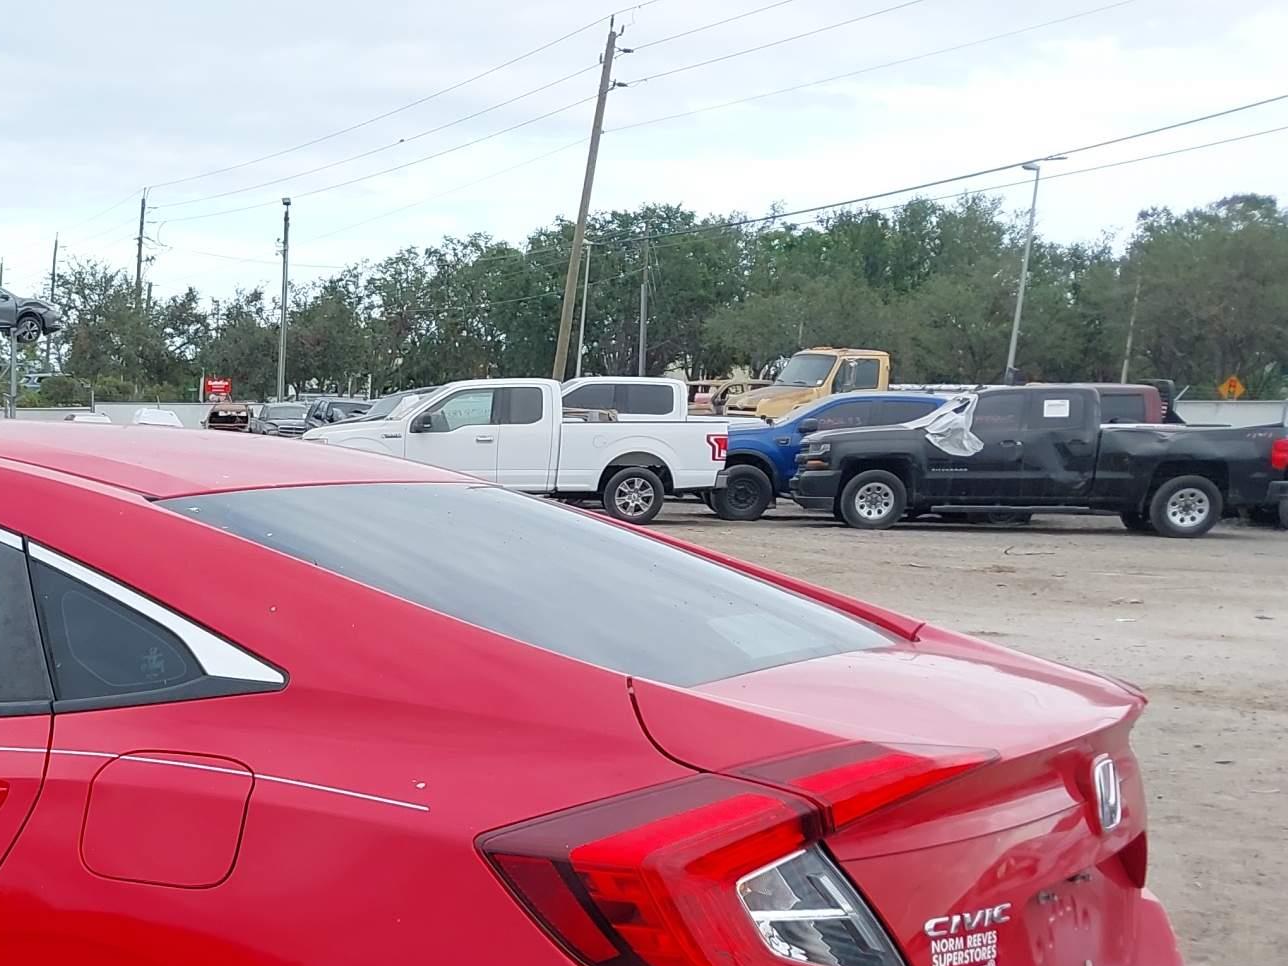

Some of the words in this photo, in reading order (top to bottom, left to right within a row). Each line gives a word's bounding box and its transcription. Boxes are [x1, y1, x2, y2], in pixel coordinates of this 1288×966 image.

[924, 902, 1012, 936] CIVIC
[931, 936, 964, 954] NORM
[967, 931, 997, 947] REEVES
